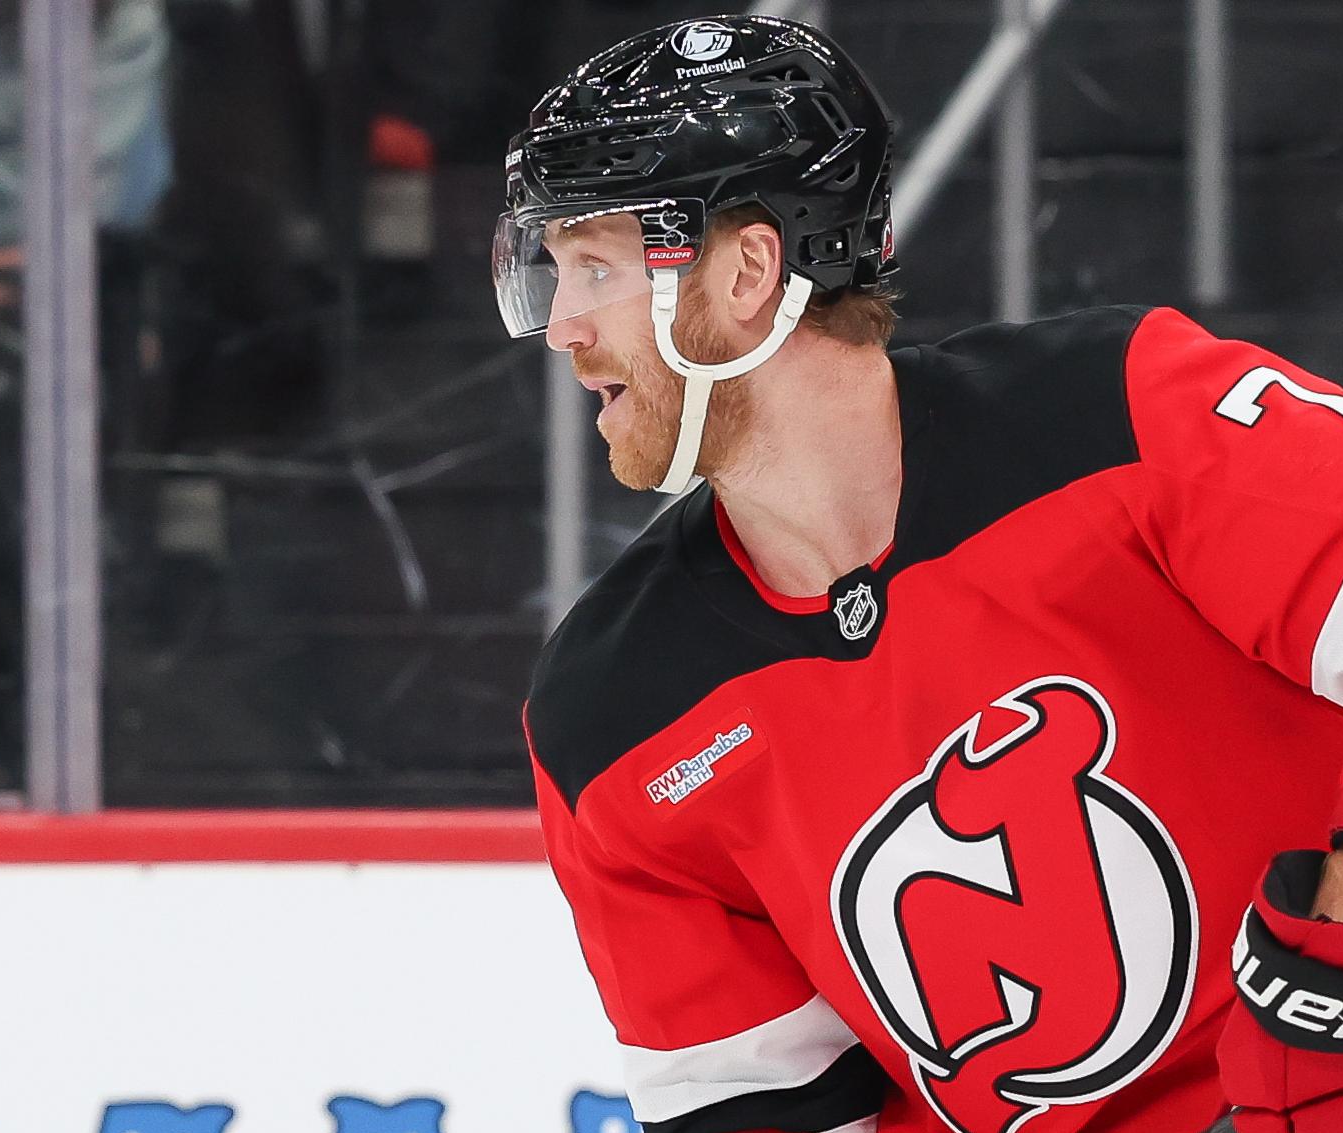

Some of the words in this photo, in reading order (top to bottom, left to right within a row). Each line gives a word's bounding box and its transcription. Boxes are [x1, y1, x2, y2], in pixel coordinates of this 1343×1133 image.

[675, 57, 747, 80] Prudential
[648, 251, 692, 260] BAUER
[668, 765, 713, 803] HEALTH
